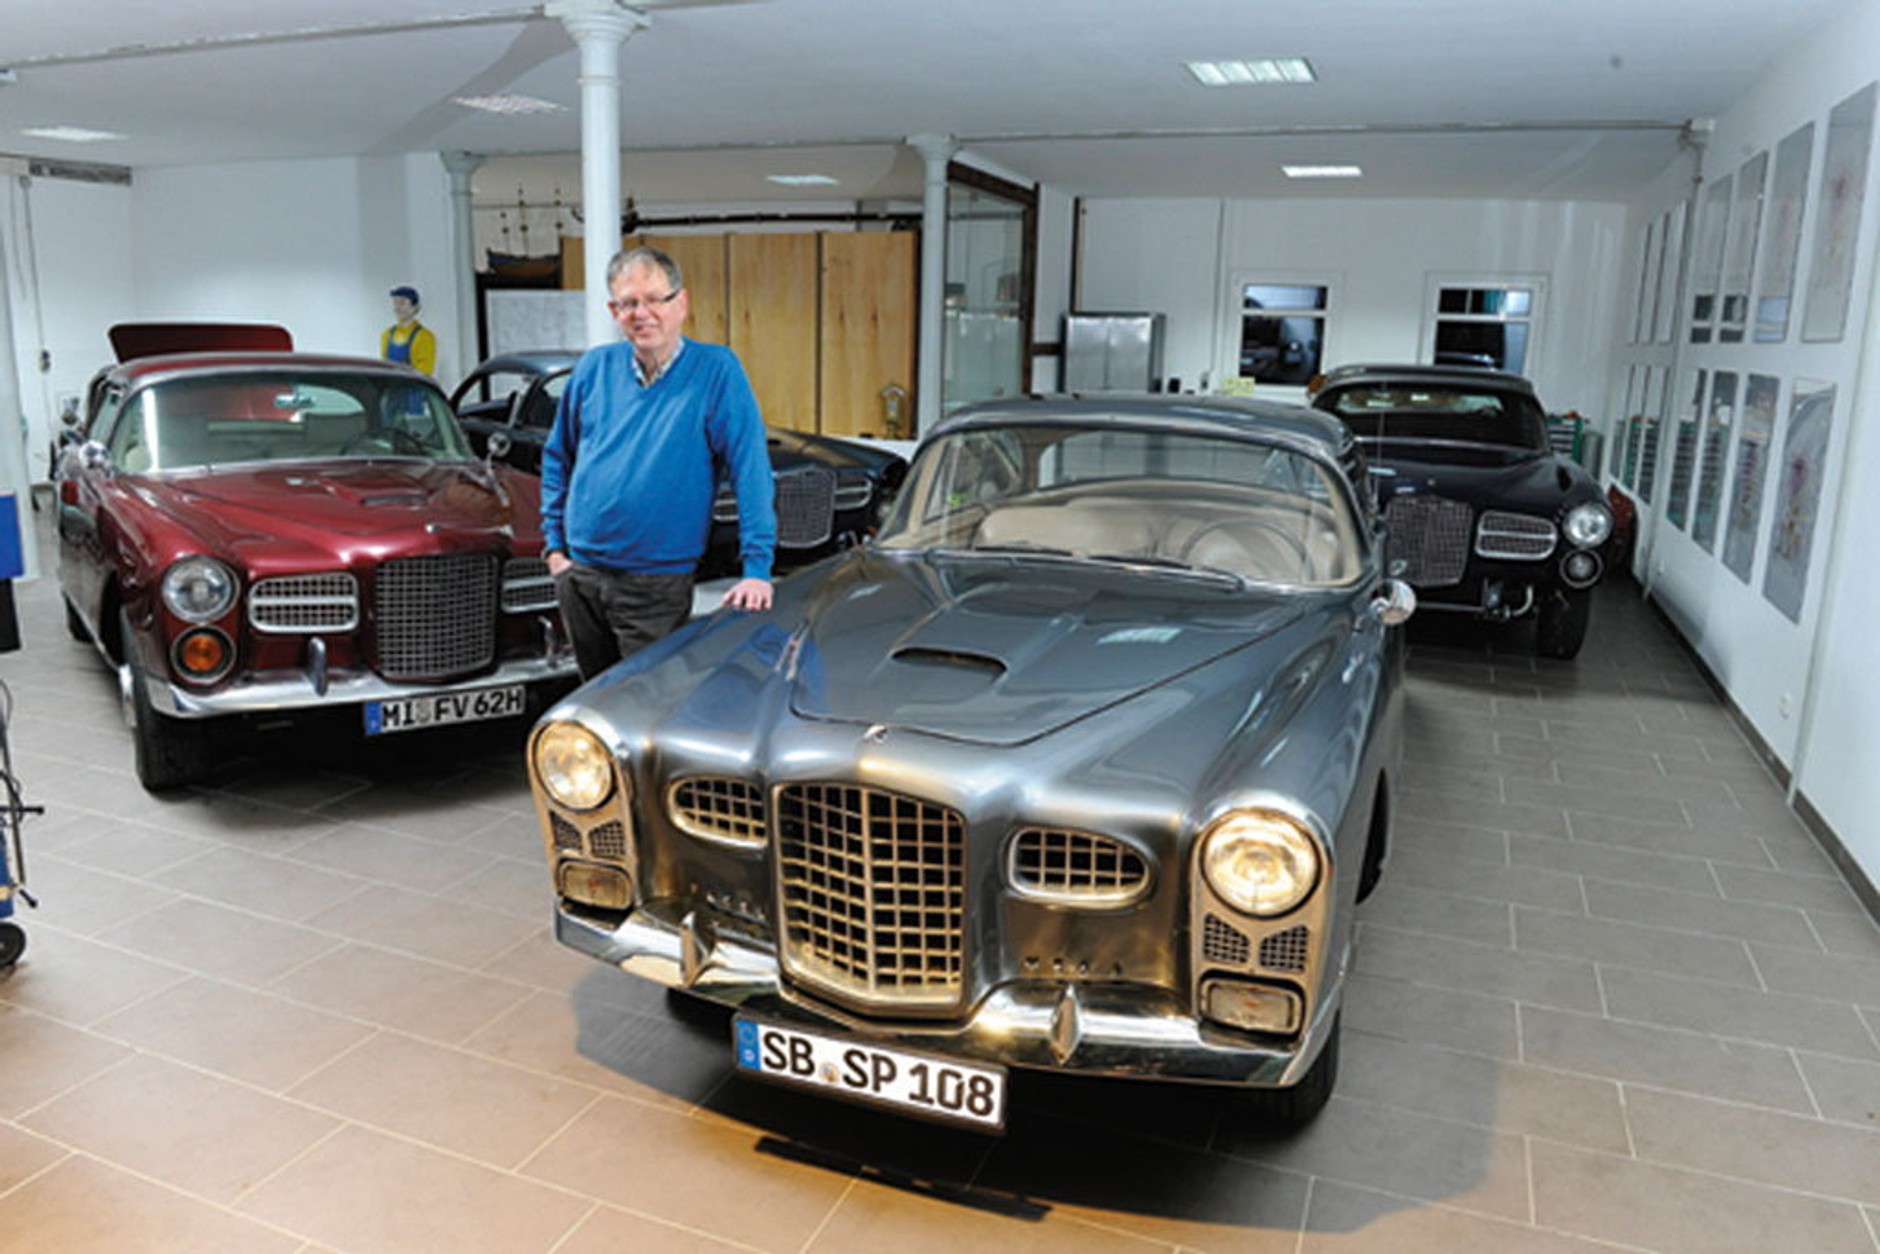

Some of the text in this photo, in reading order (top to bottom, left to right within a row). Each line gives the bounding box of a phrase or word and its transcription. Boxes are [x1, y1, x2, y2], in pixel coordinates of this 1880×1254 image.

[382, 702, 415, 727] MI
[434, 695, 469, 721] FV
[474, 688, 522, 715] 62H
[763, 1031, 995, 1116] SB SP 108
